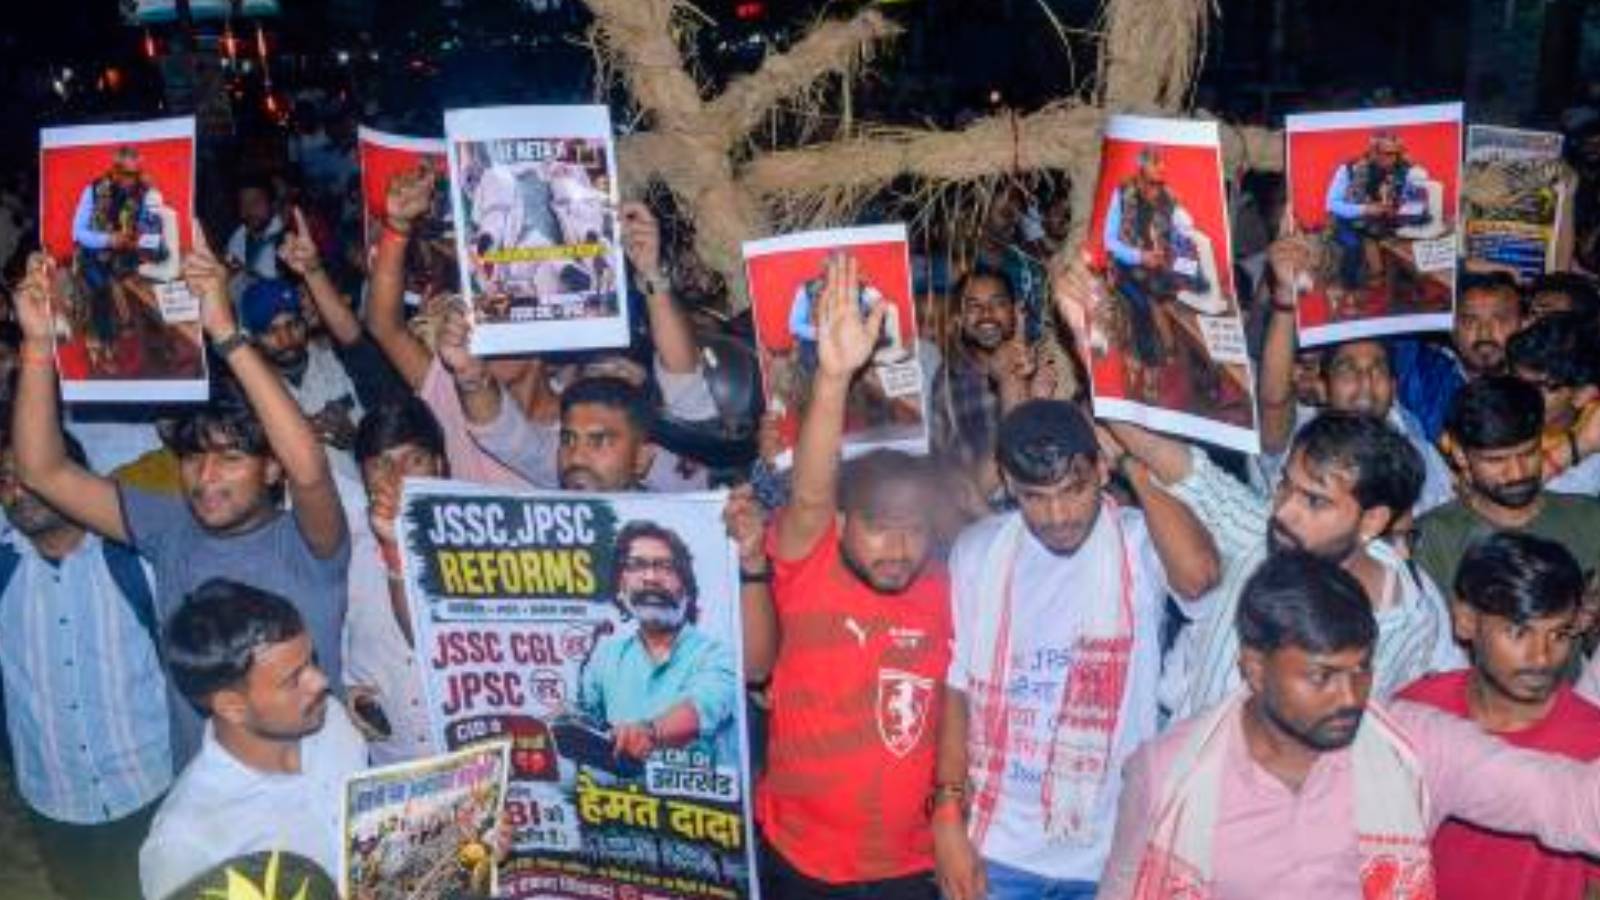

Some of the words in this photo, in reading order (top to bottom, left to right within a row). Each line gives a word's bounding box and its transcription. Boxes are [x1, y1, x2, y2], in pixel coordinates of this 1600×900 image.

[517, 503, 595, 543] JPSC
[439, 550, 596, 594] REFORMS
[433, 631, 503, 668] JSSC
[510, 632, 563, 664] CGL
[443, 671, 524, 715] JPSC
[504, 800, 540, 826] BI
[577, 765, 660, 829] हेमंत
[667, 800, 741, 848] दादा
